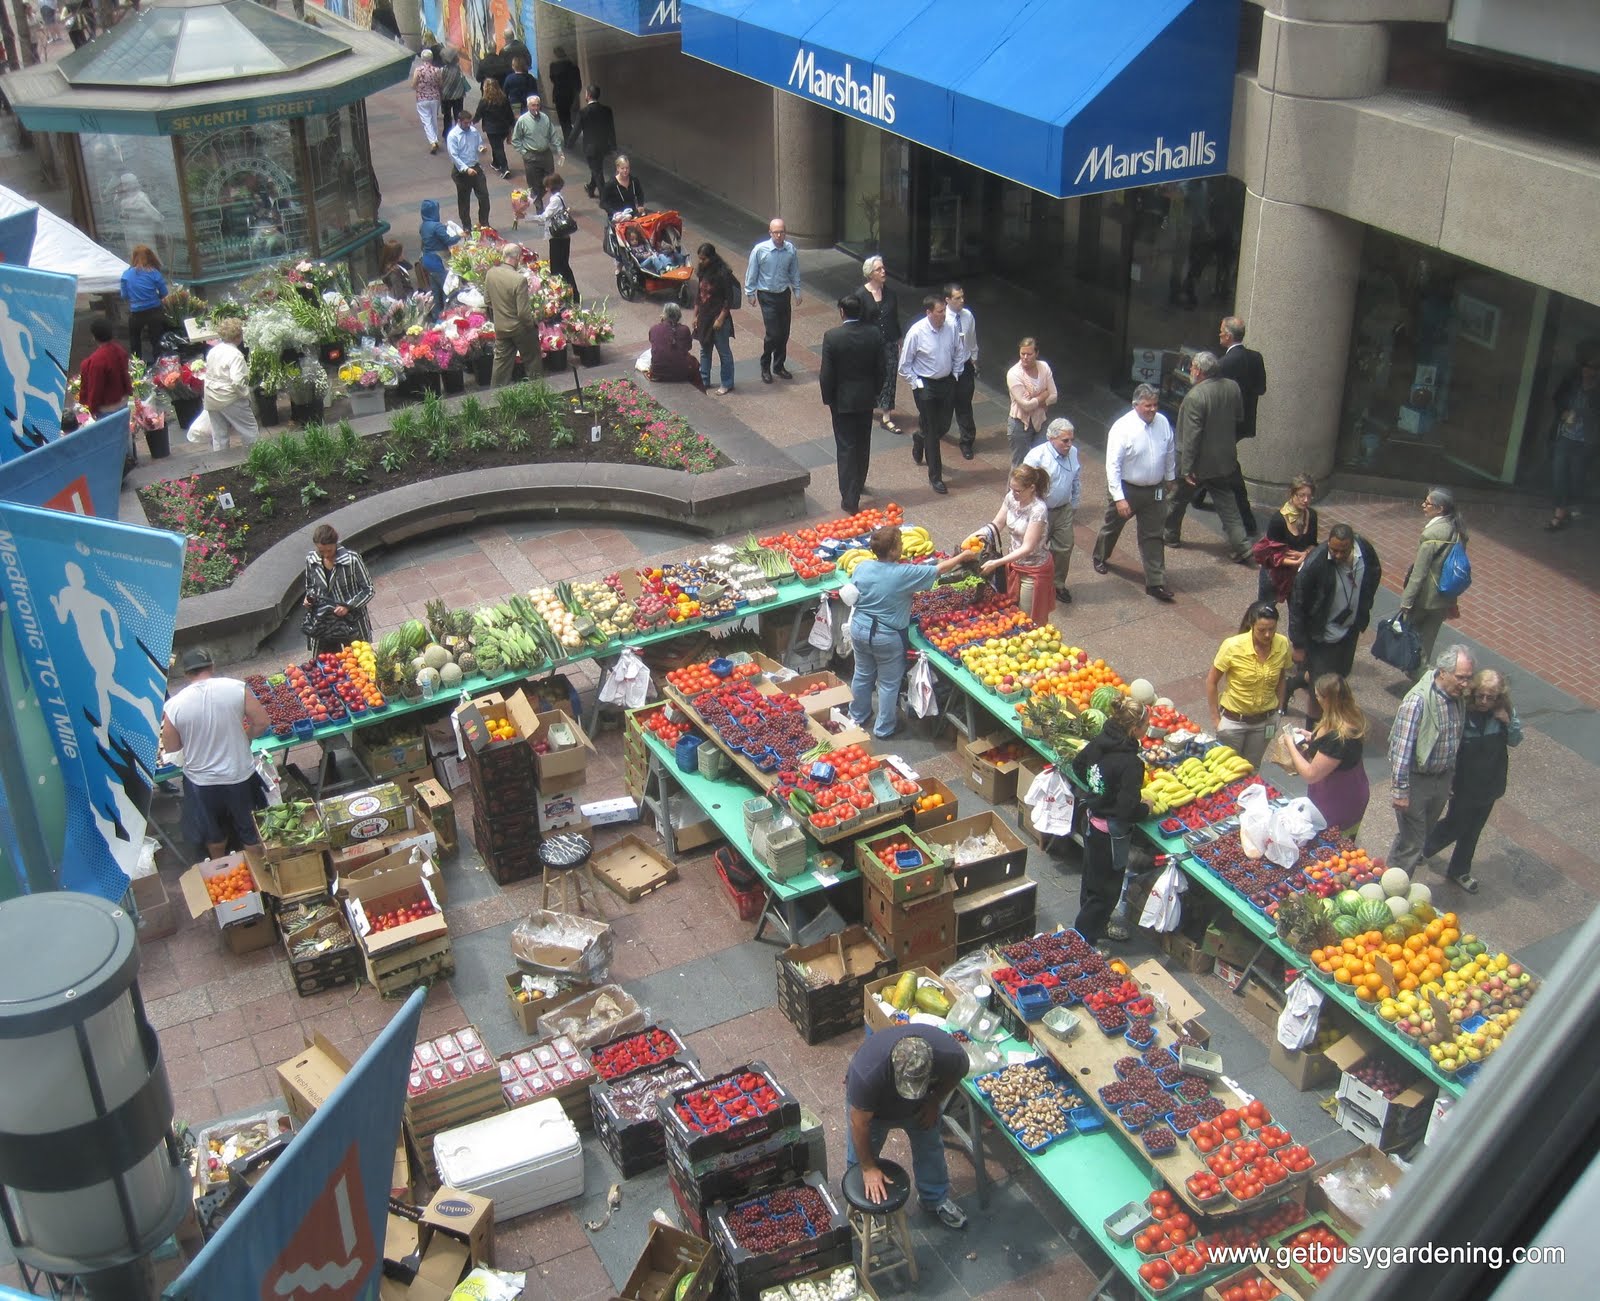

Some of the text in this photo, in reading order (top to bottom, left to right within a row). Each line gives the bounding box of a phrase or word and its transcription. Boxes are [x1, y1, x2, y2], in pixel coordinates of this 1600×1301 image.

[788, 48, 896, 125] Marshalls
[172, 100, 314, 131] SEVENTH STREET
[1074, 131, 1216, 185] Marshalls
[0, 530, 78, 759] Medtronic TC 1 Mile
[293, 1074, 309, 1090] fresh
[438, 1204, 473, 1214] Sunkist
